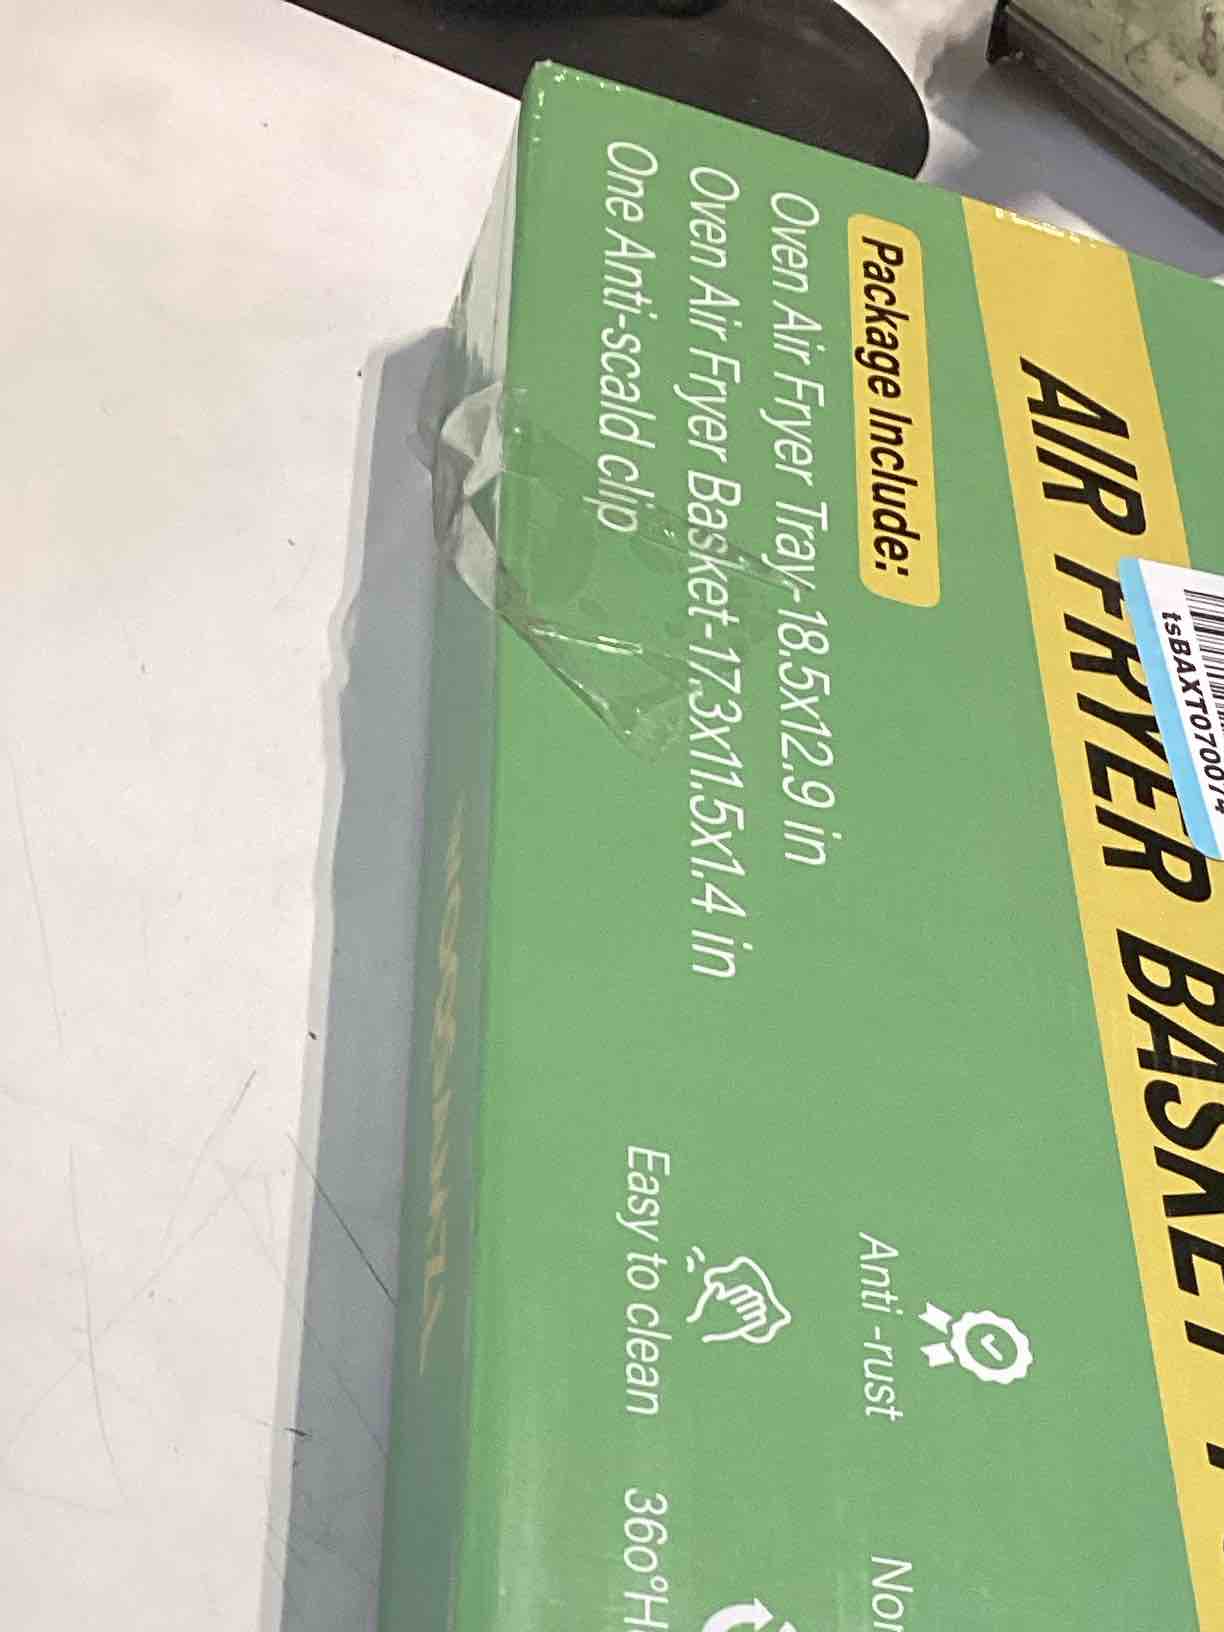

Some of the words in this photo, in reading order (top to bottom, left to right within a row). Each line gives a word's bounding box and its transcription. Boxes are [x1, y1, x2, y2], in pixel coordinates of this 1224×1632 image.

[604, 141, 659, 223] One
[688, 166, 741, 269] Oven
[770, 191, 820, 293] Oven
[598, 228, 658, 449] Anti-scald
[688, 275, 744, 342] Air
[773, 299, 825, 367] Air
[854, 236, 910, 400] Package
[673, 346, 742, 463] Fryer
[760, 373, 825, 487] Fryer
[1019, 355, 1148, 536] AIR
[583, 453, 656, 532] clip
[869, 407, 921, 576] Include:
[783, 819, 843, 867] in
[691, 929, 753, 978] in
[615, 1144, 671, 1242] Easy
[625, 1251, 668, 1291] to
[624, 1300, 673, 1417] clean
